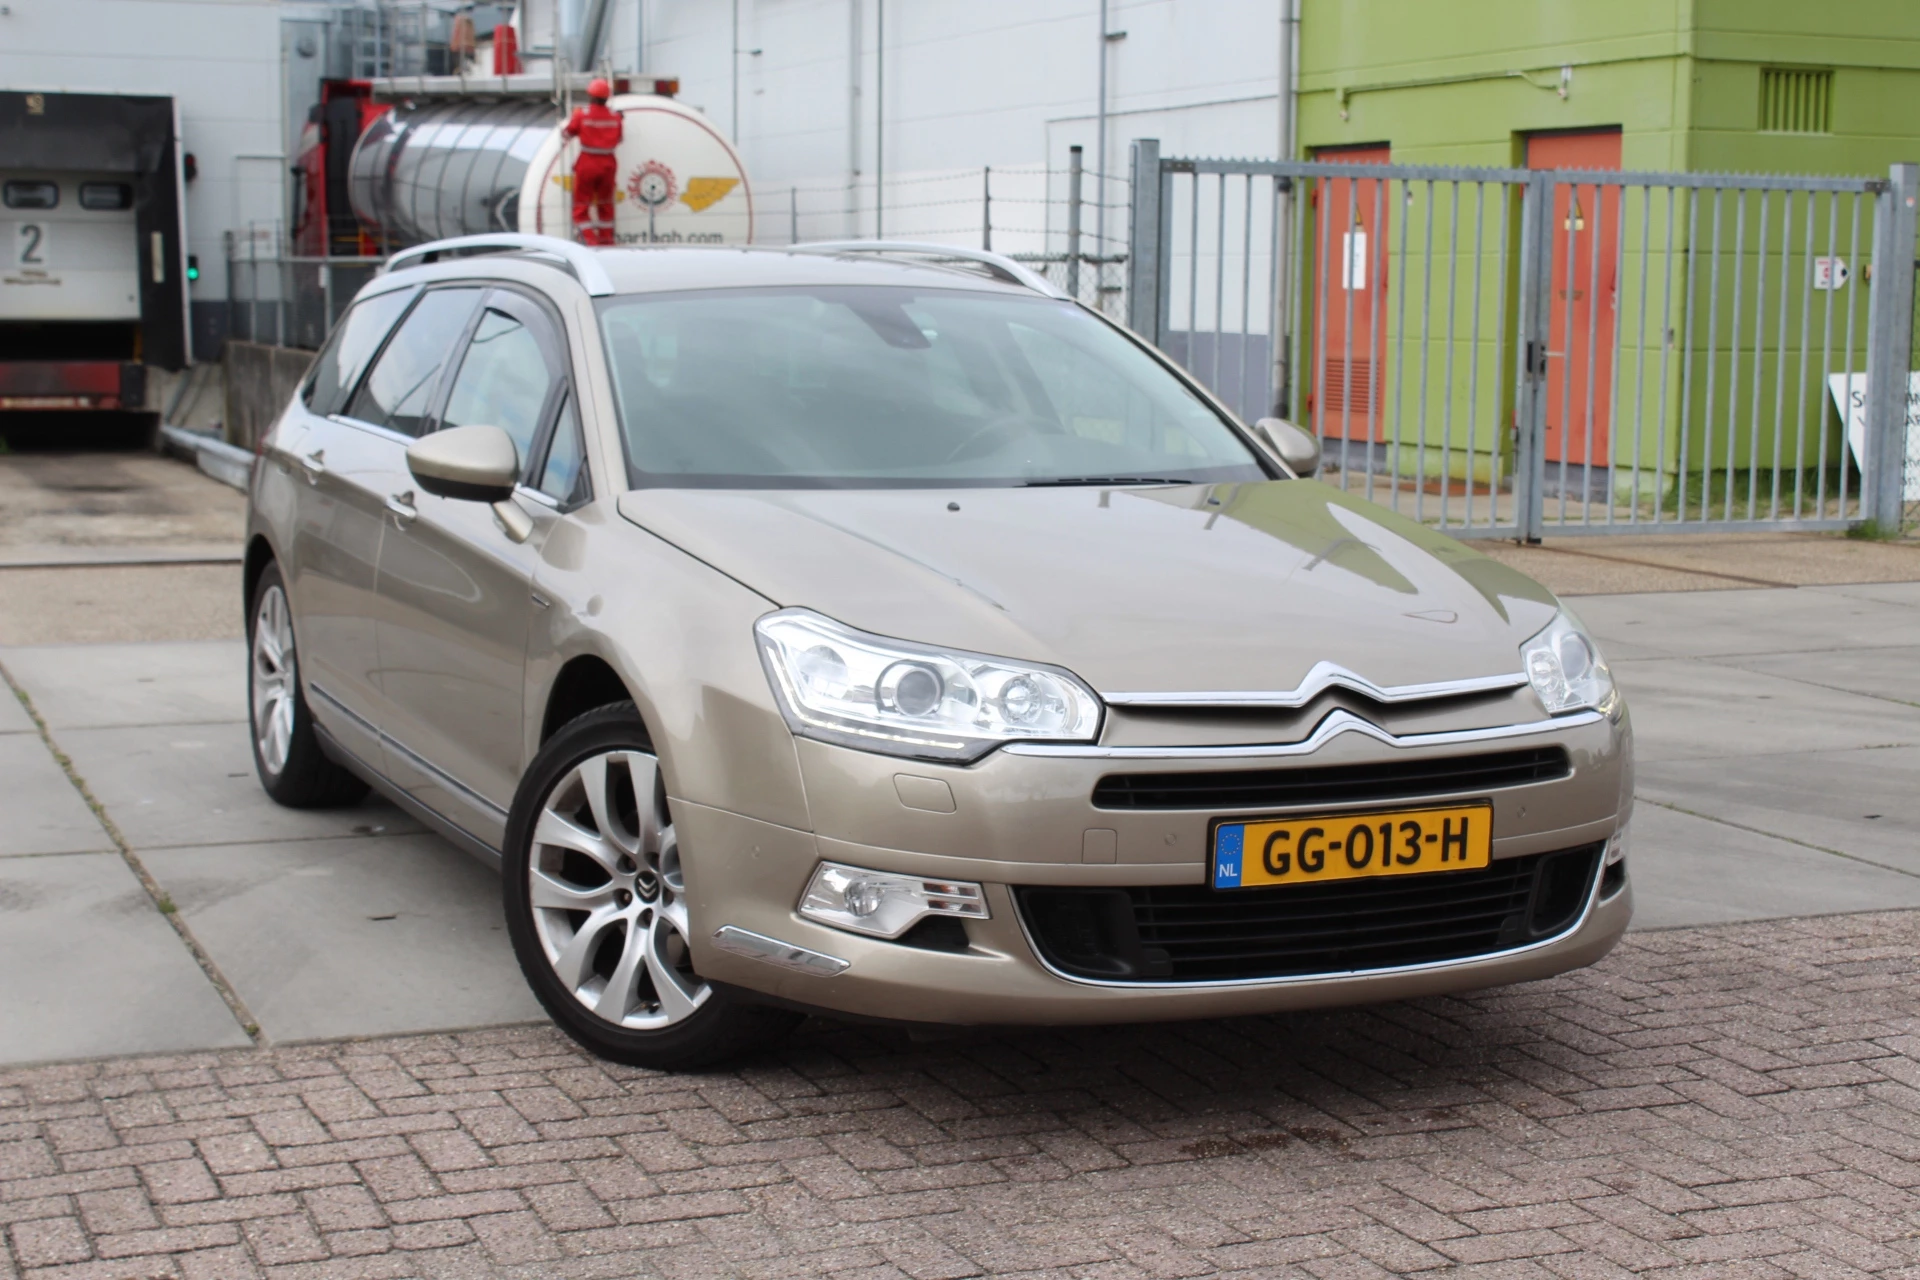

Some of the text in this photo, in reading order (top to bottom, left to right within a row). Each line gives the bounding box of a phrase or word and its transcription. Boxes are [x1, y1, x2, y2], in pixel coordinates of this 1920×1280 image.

[20, 224, 43, 263] 2
[1263, 817, 1469, 875] GG-013-H
[1219, 863, 1238, 877] NL
